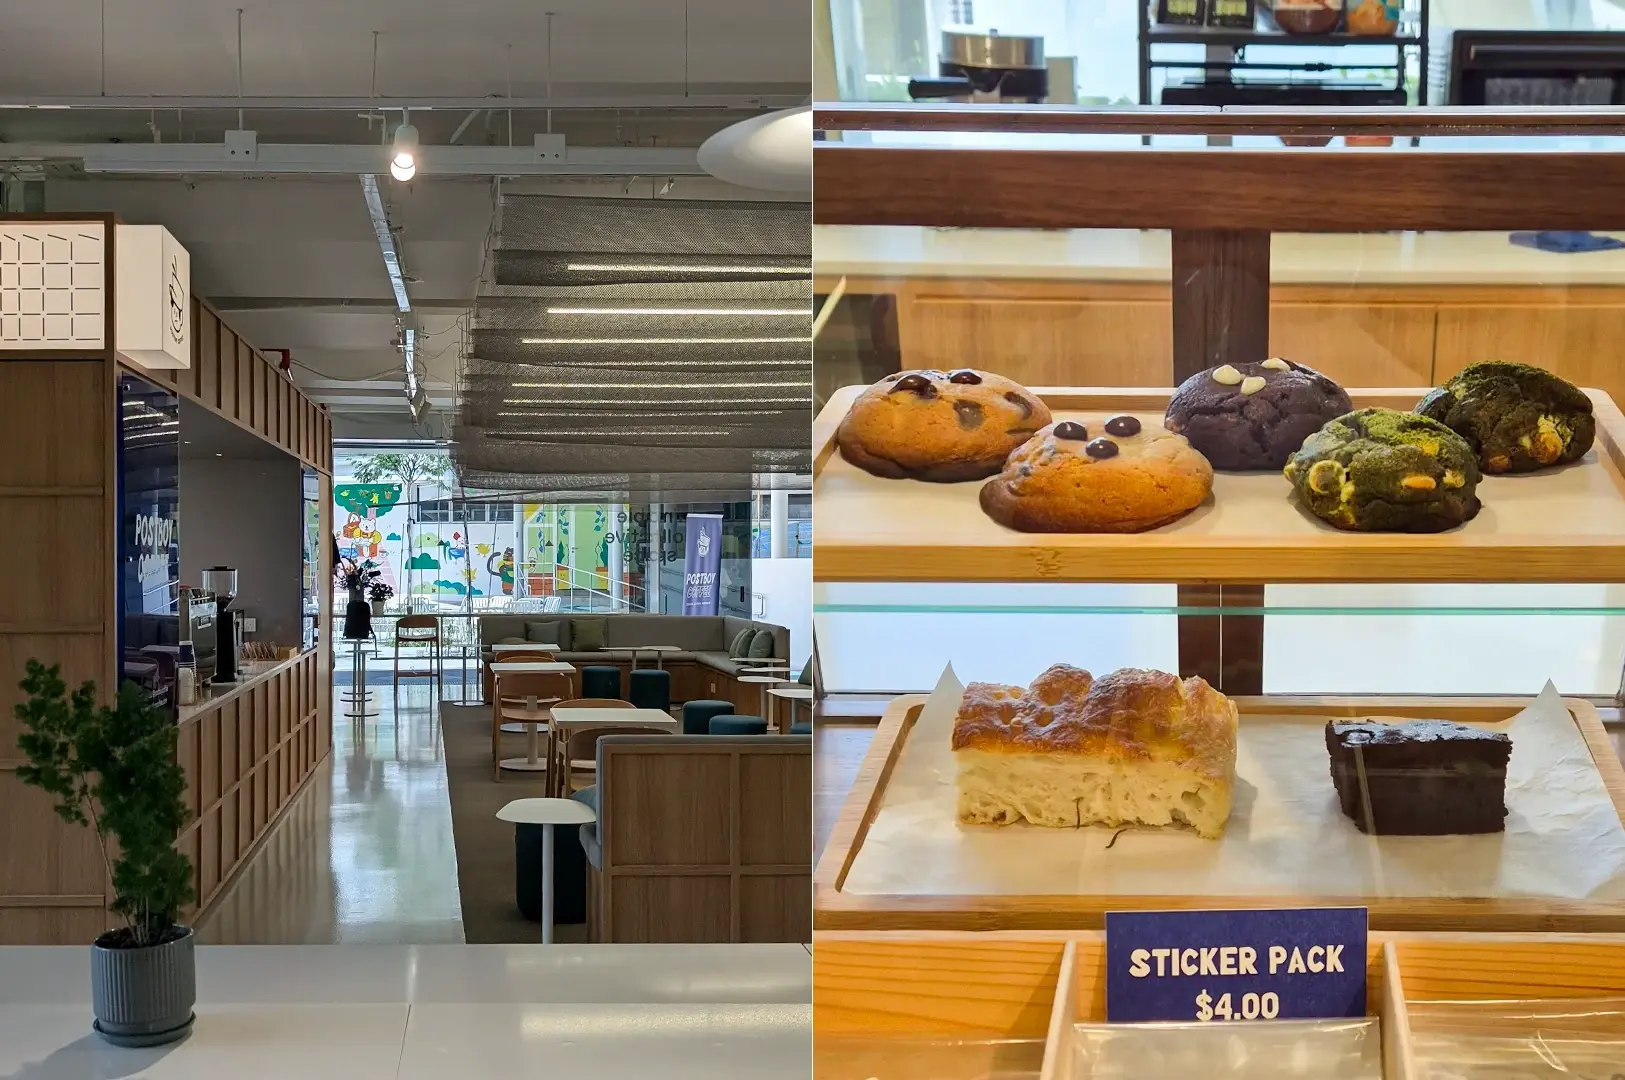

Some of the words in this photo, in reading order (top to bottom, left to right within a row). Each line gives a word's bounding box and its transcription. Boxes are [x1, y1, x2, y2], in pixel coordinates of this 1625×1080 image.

[135, 514, 173, 546] POSTBOY
[686, 572, 716, 585] POSTBOY
[687, 585, 712, 598] COFFEE
[1128, 946, 1259, 978] STICKER
[1268, 944, 1345, 975] PACK
[1195, 989, 1280, 1021] $4.00
